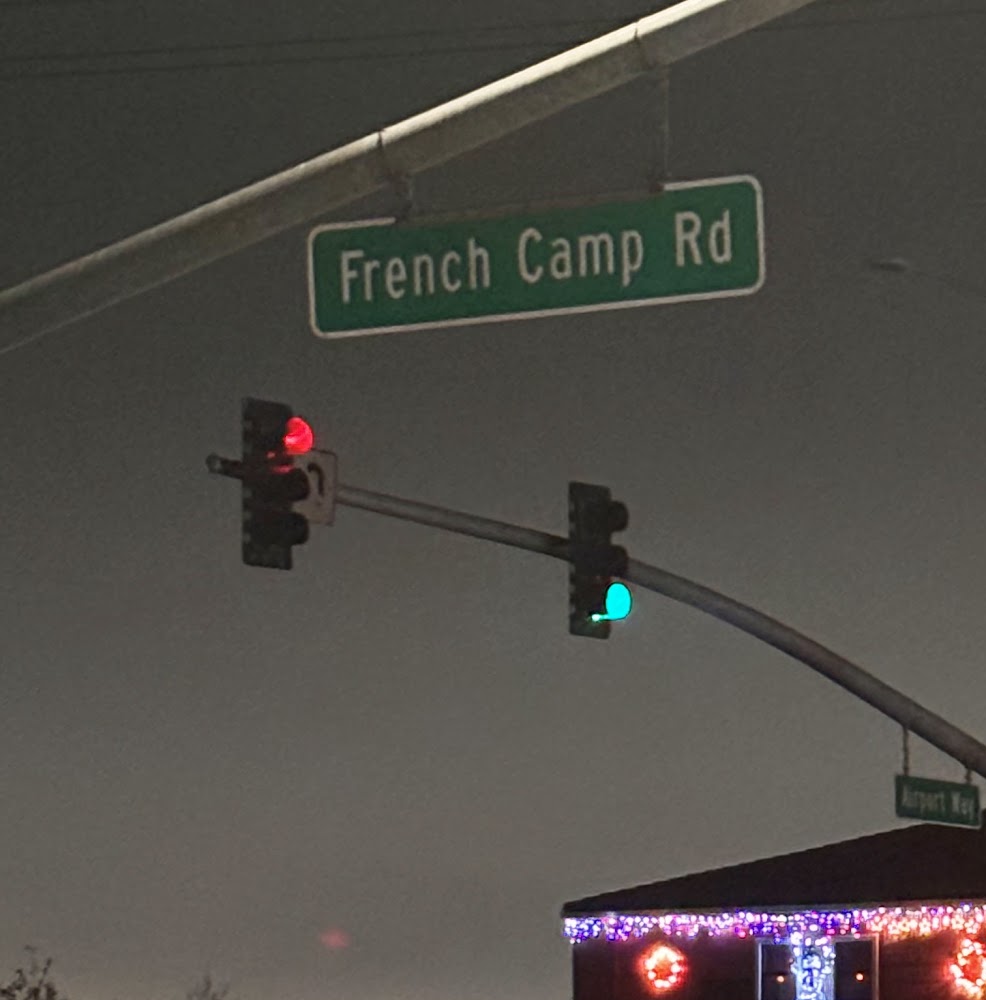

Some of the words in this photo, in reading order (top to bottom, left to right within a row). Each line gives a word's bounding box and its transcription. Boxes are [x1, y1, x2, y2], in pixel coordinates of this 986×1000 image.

[341, 238, 490, 303] French
[518, 228, 643, 286] Camp
[674, 209, 732, 266] Rd
